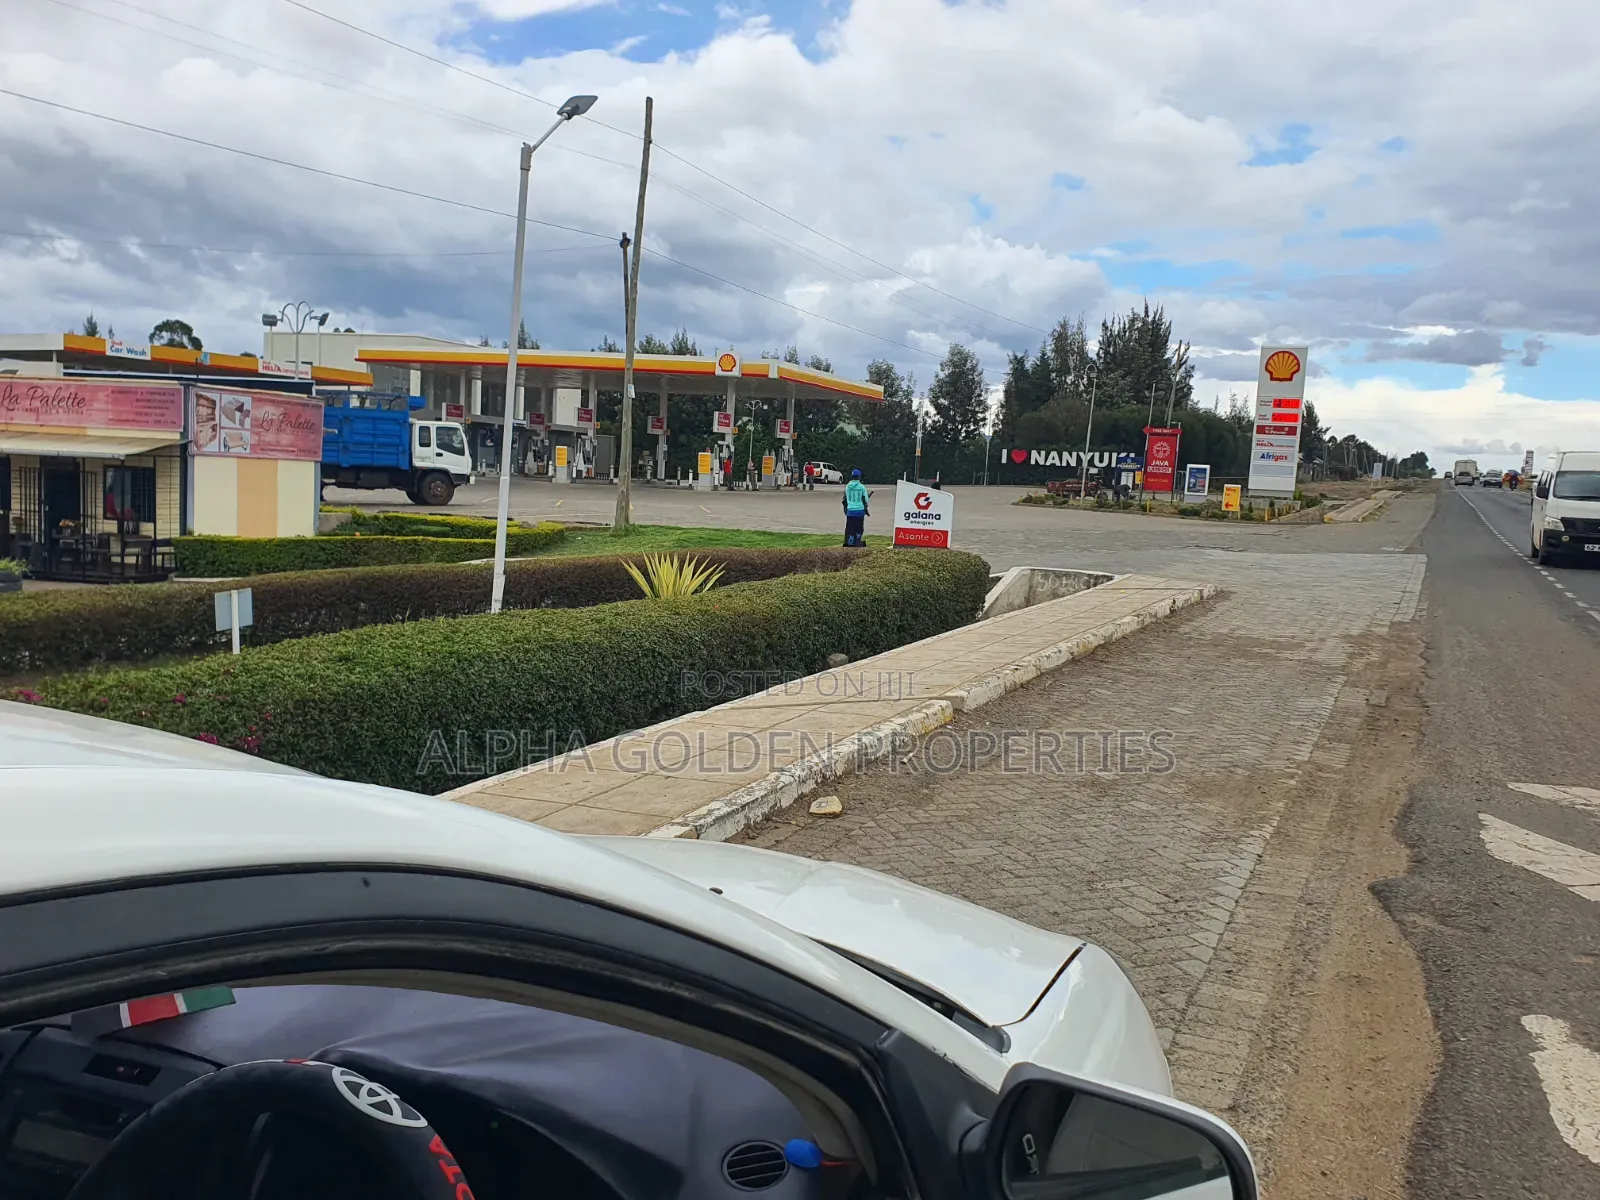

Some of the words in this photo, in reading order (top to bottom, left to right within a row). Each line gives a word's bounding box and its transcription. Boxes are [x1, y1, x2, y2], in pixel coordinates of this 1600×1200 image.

[110, 345, 123, 353] Car
[126, 346, 147, 356] Wash
[0, 384, 20, 411] La
[26, 386, 87, 408] Palette
[260, 410, 274, 432] La
[278, 413, 316, 430] Palette
[1001, 449, 1008, 464] I
[1260, 452, 1288, 462] Afrigas
[904, 511, 941, 520] galana
[898, 532, 930, 541] Asante
